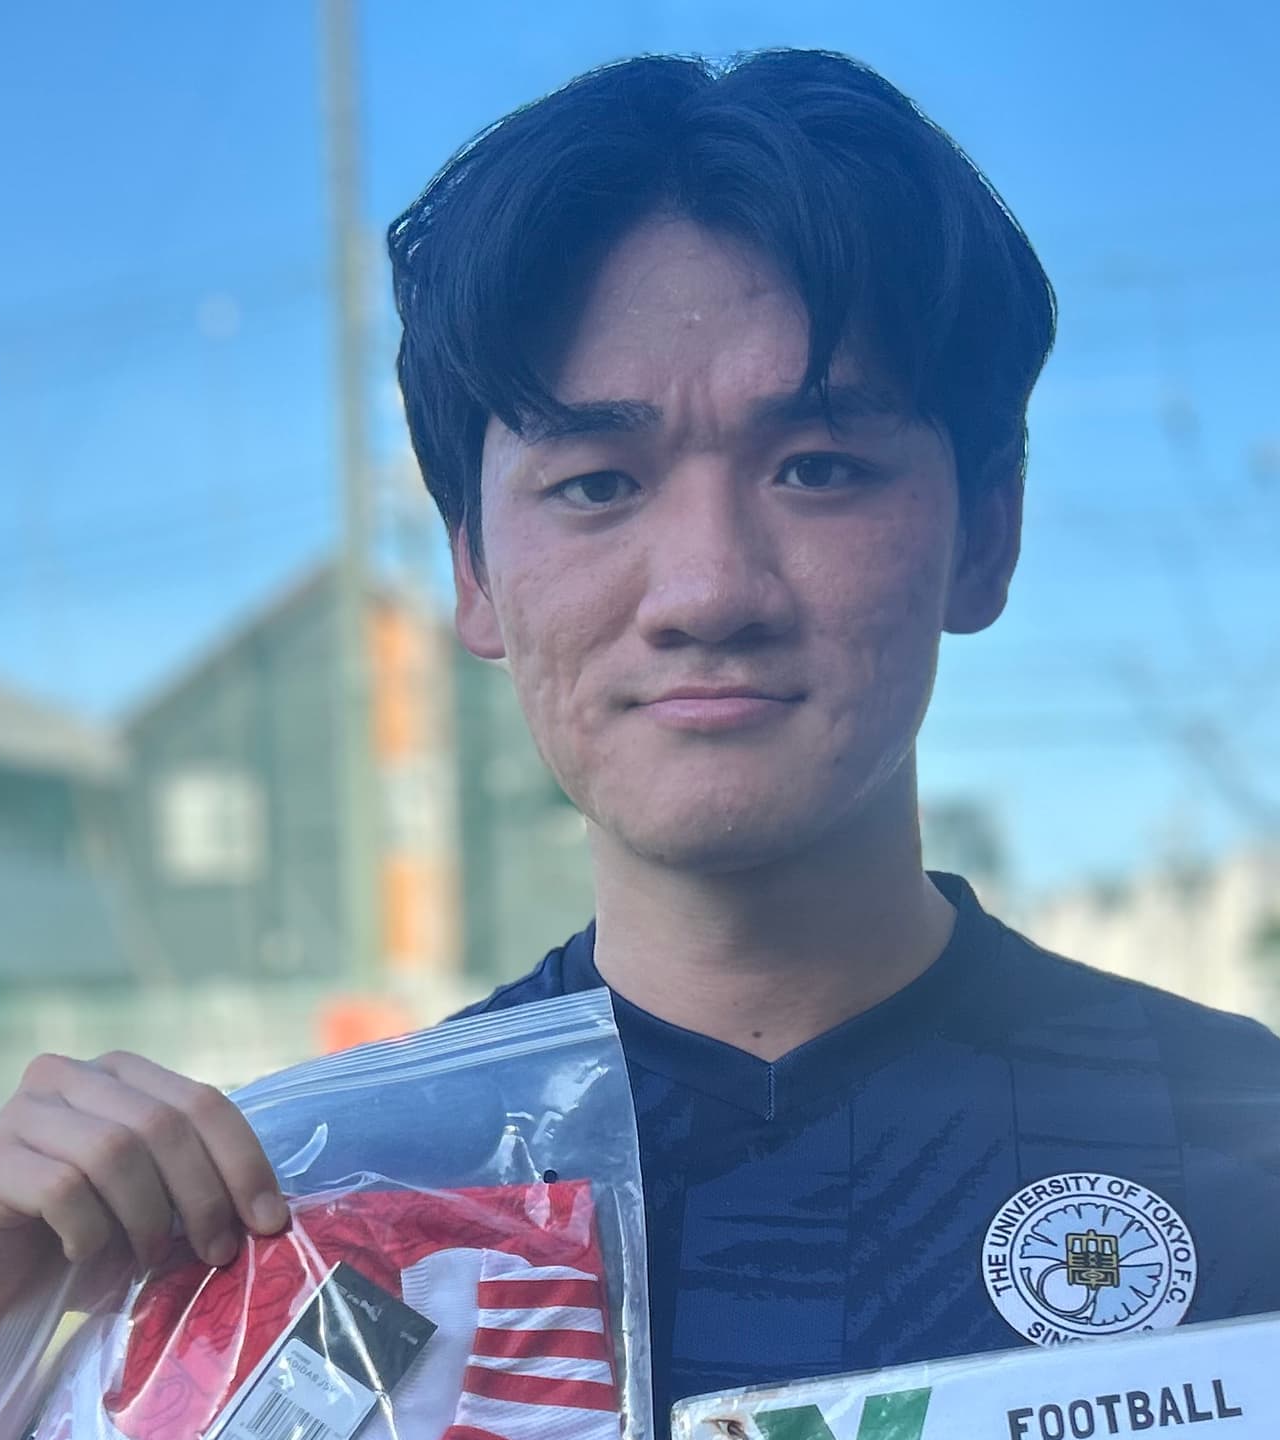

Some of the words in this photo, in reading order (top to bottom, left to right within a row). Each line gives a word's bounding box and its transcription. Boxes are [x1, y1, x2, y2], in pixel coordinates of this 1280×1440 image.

[1107, 1179, 1141, 1200] OF
[988, 1175, 1100, 1249] UNIVERSITY
[1145, 1194, 1192, 1264] TOKYO
[987, 1253, 1012, 1298] THE
[1165, 1267, 1193, 1305] F.C.
[1026, 1320, 1096, 1347] SIN
